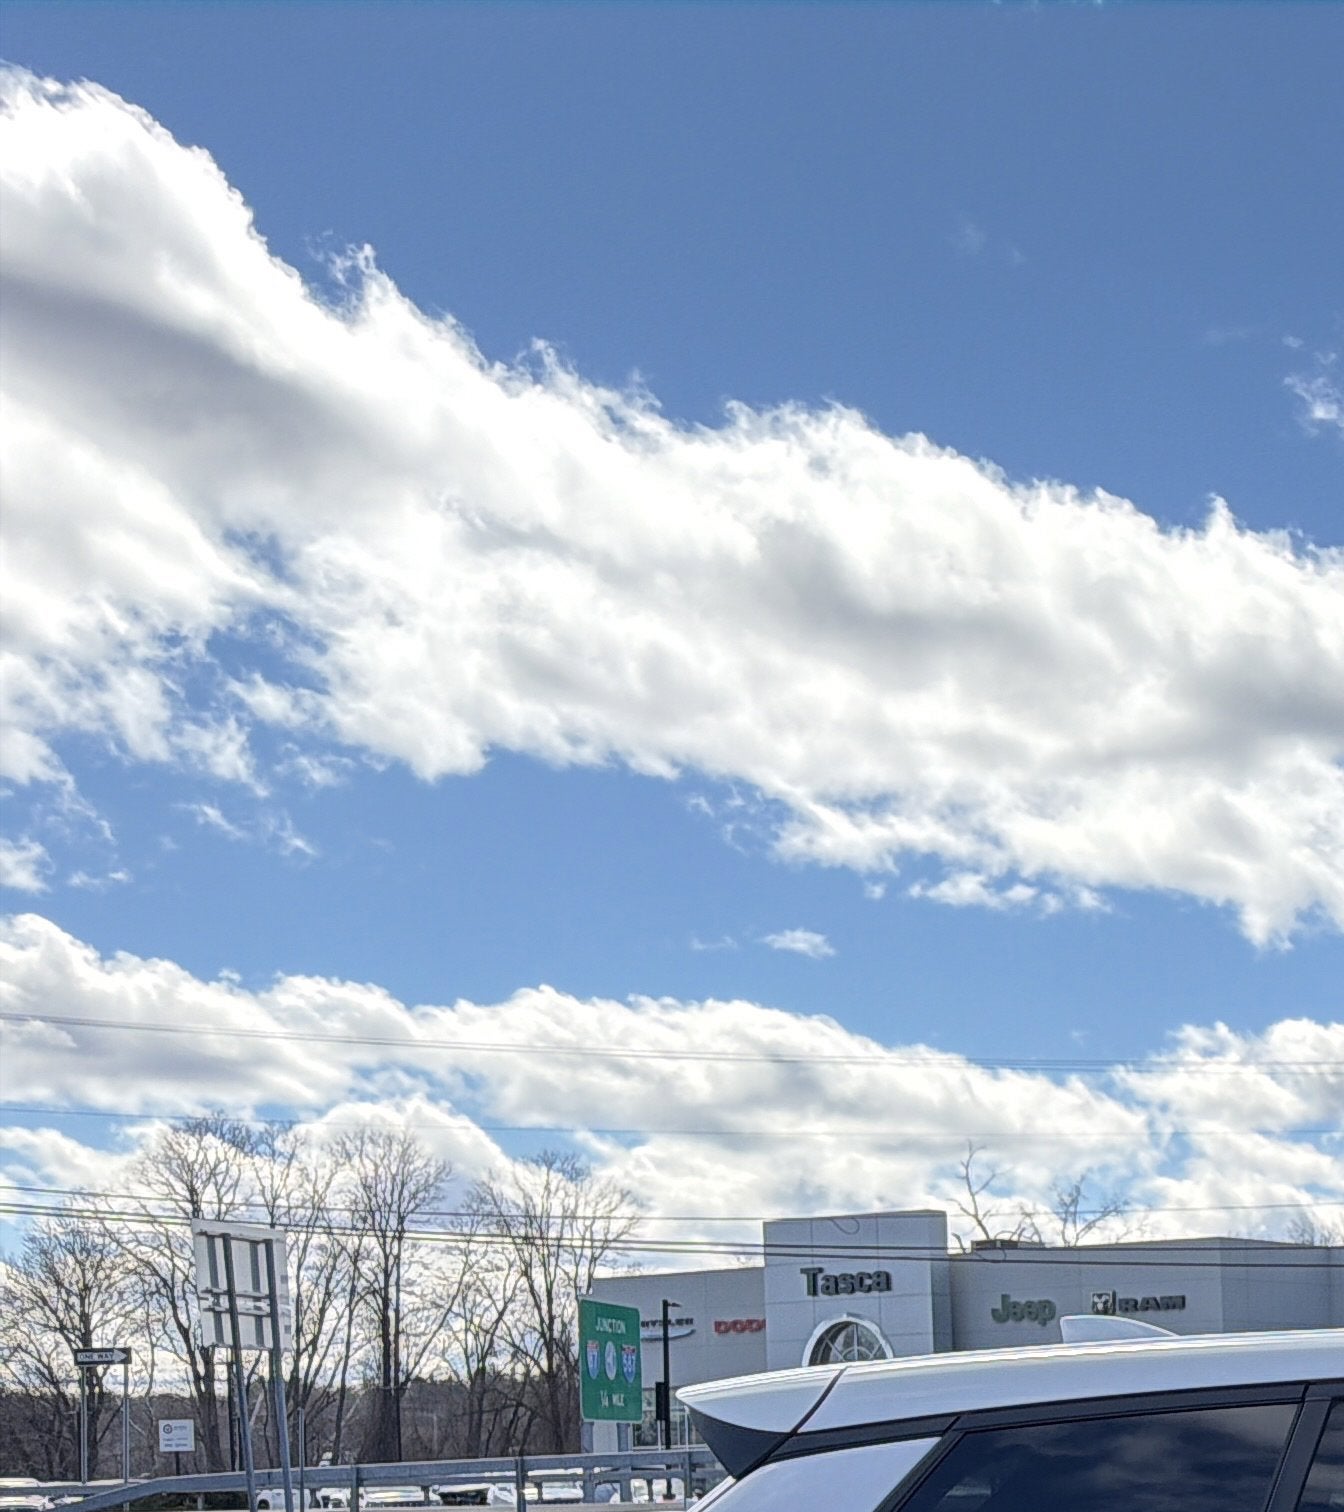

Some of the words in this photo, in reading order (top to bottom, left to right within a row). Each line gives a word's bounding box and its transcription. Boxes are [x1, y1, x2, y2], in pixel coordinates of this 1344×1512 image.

[800, 1267, 892, 1297] Tasca
[991, 1294, 1056, 1326] Jeep
[1118, 1295, 1186, 1313] RAM
[595, 1316, 626, 1334] JUNCTION
[79, 1353, 93, 1361] ONE
[97, 1352, 113, 1361] WAY
